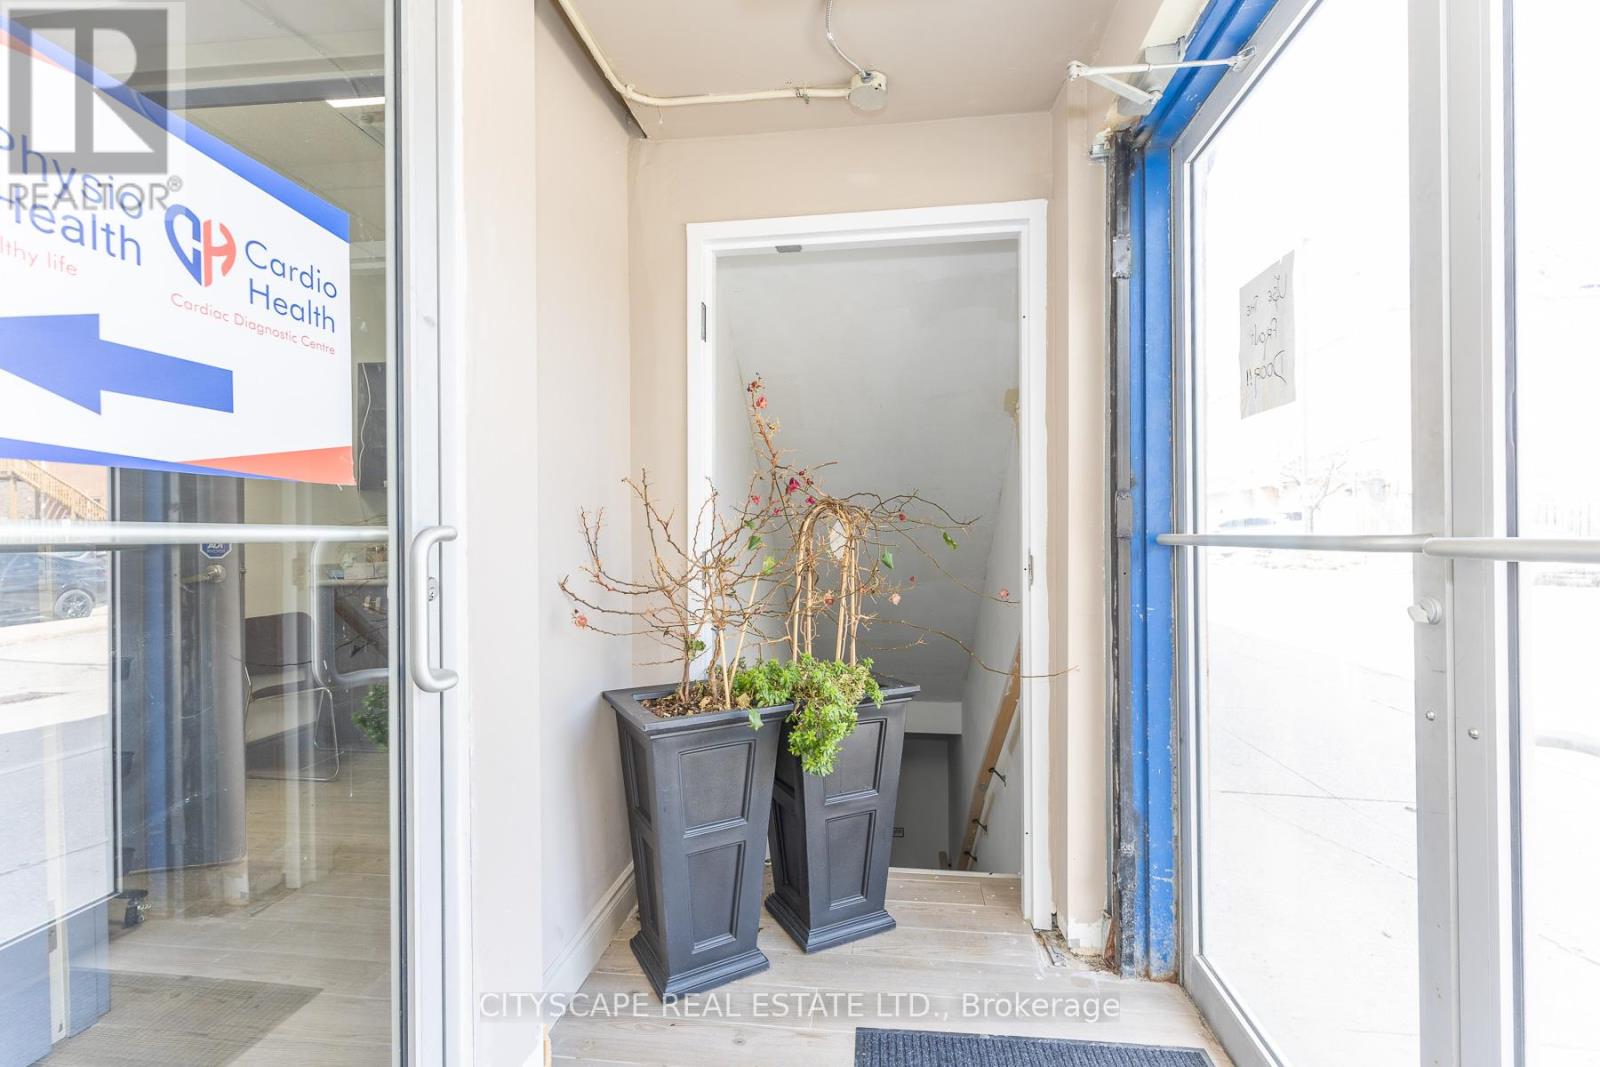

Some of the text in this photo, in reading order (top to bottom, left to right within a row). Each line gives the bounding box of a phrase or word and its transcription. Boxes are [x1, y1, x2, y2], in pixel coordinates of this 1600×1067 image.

[47, 251, 79, 276] life
[245, 240, 337, 299] Cardio
[170, 292, 336, 355] Cardiac Diagnostic Centre
[249, 277, 335, 333] Health
